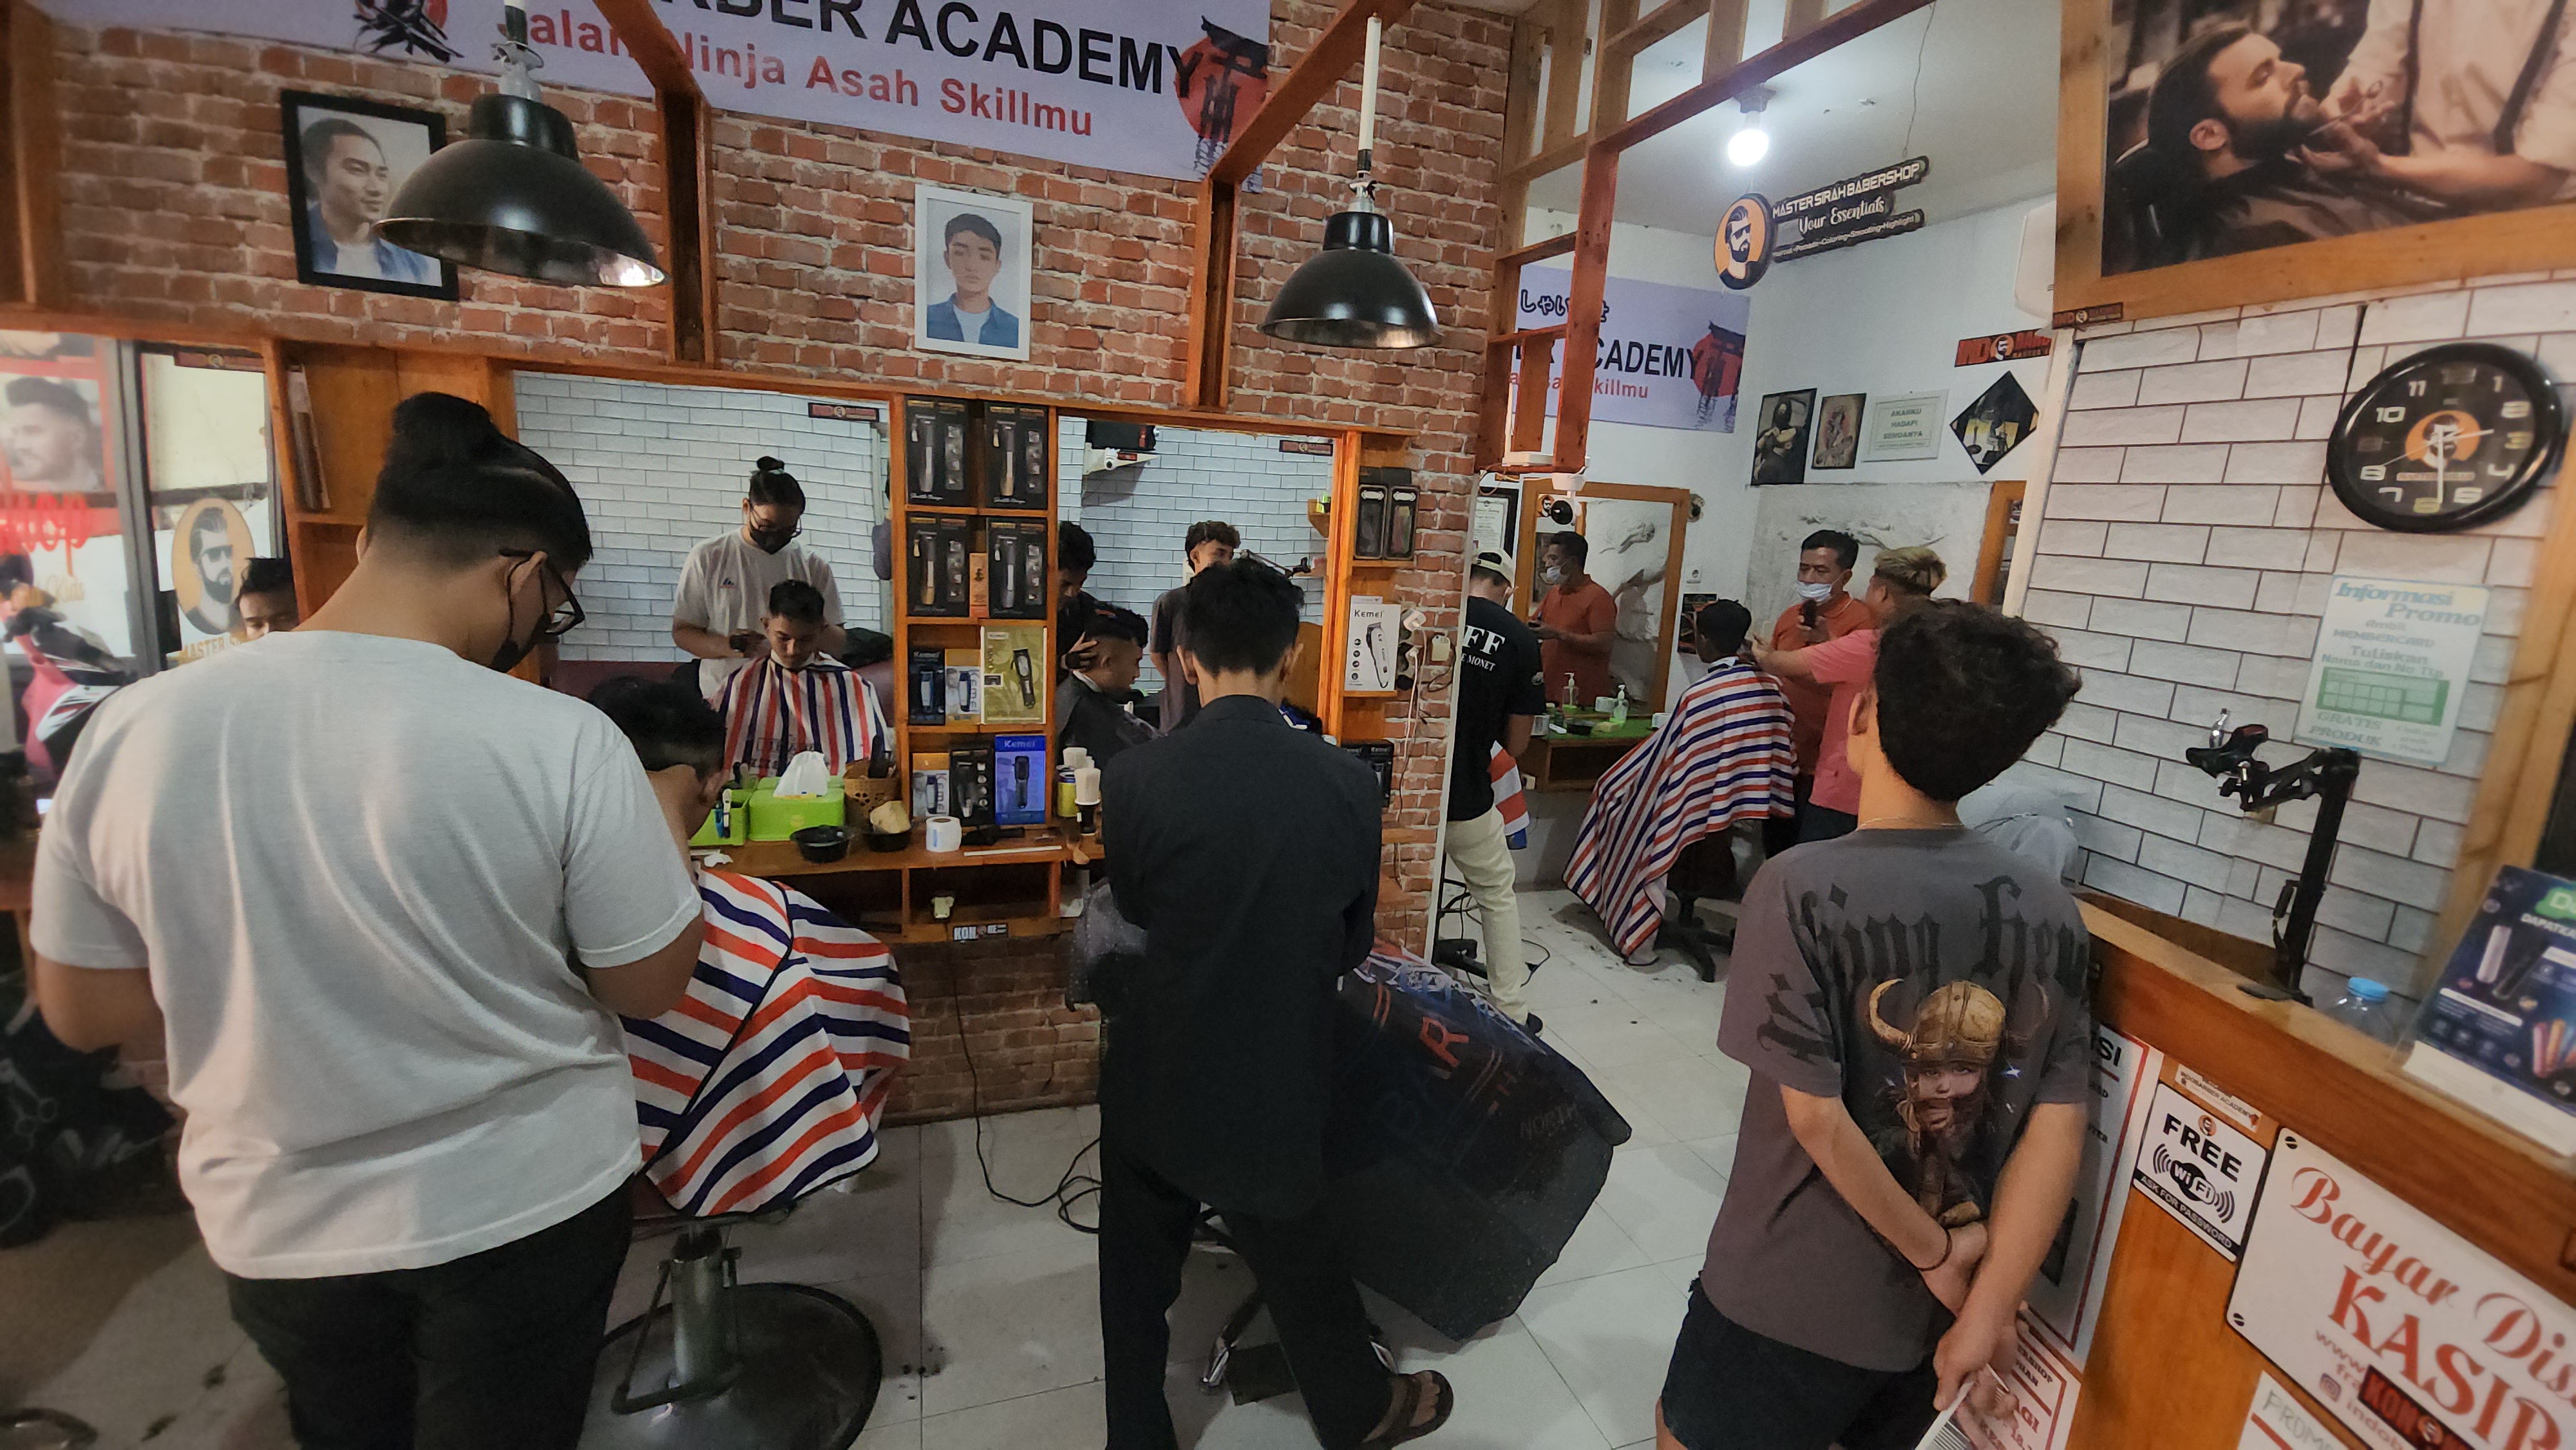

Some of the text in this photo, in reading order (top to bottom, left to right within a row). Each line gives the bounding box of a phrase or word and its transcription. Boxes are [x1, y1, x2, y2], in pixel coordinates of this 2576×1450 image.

[885, 0, 1202, 99] ACADEMY
[806, 55, 918, 107] Asah
[940, 77, 1092, 137] Skillmu
[1772, 163, 1920, 219] MASTER SIRAH BABERSHOP
[1799, 195, 1886, 234] Your Essentials
[1594, 337, 1704, 380] ADEMY
[1594, 377, 1649, 399] killmu
[2409, 375, 2503, 397] 11 1
[2376, 406, 2406, 423] 10
[2488, 463, 2515, 480] 4
[2378, 486, 2403, 503] 7
[2336, 581, 2455, 607] Informasi
[2385, 602, 2479, 626] Promo
[1462, 625, 1506, 655] FF
[1468, 654, 1496, 672] MONET
[2322, 654, 2360, 667] Nama
[2364, 659, 2391, 671] dan
[2394, 663, 2416, 674] No
[2351, 645, 2429, 666] Tuliskan
[2318, 711, 2382, 730] GRATIS
[2308, 725, 2383, 747] PRODUK
[2090, 1031, 2122, 1067] SI
[2163, 1113, 2242, 1183] FREE
[2141, 1174, 2233, 1248] ASK FOR PASSWORD
[2290, 1166, 2576, 1409] Bayar Dis
[2316, 1329, 2367, 1375] www
[2328, 1265, 2562, 1450] KASIR
[2336, 1362, 2363, 1390] fra
[2346, 1398, 2403, 1450] indob
